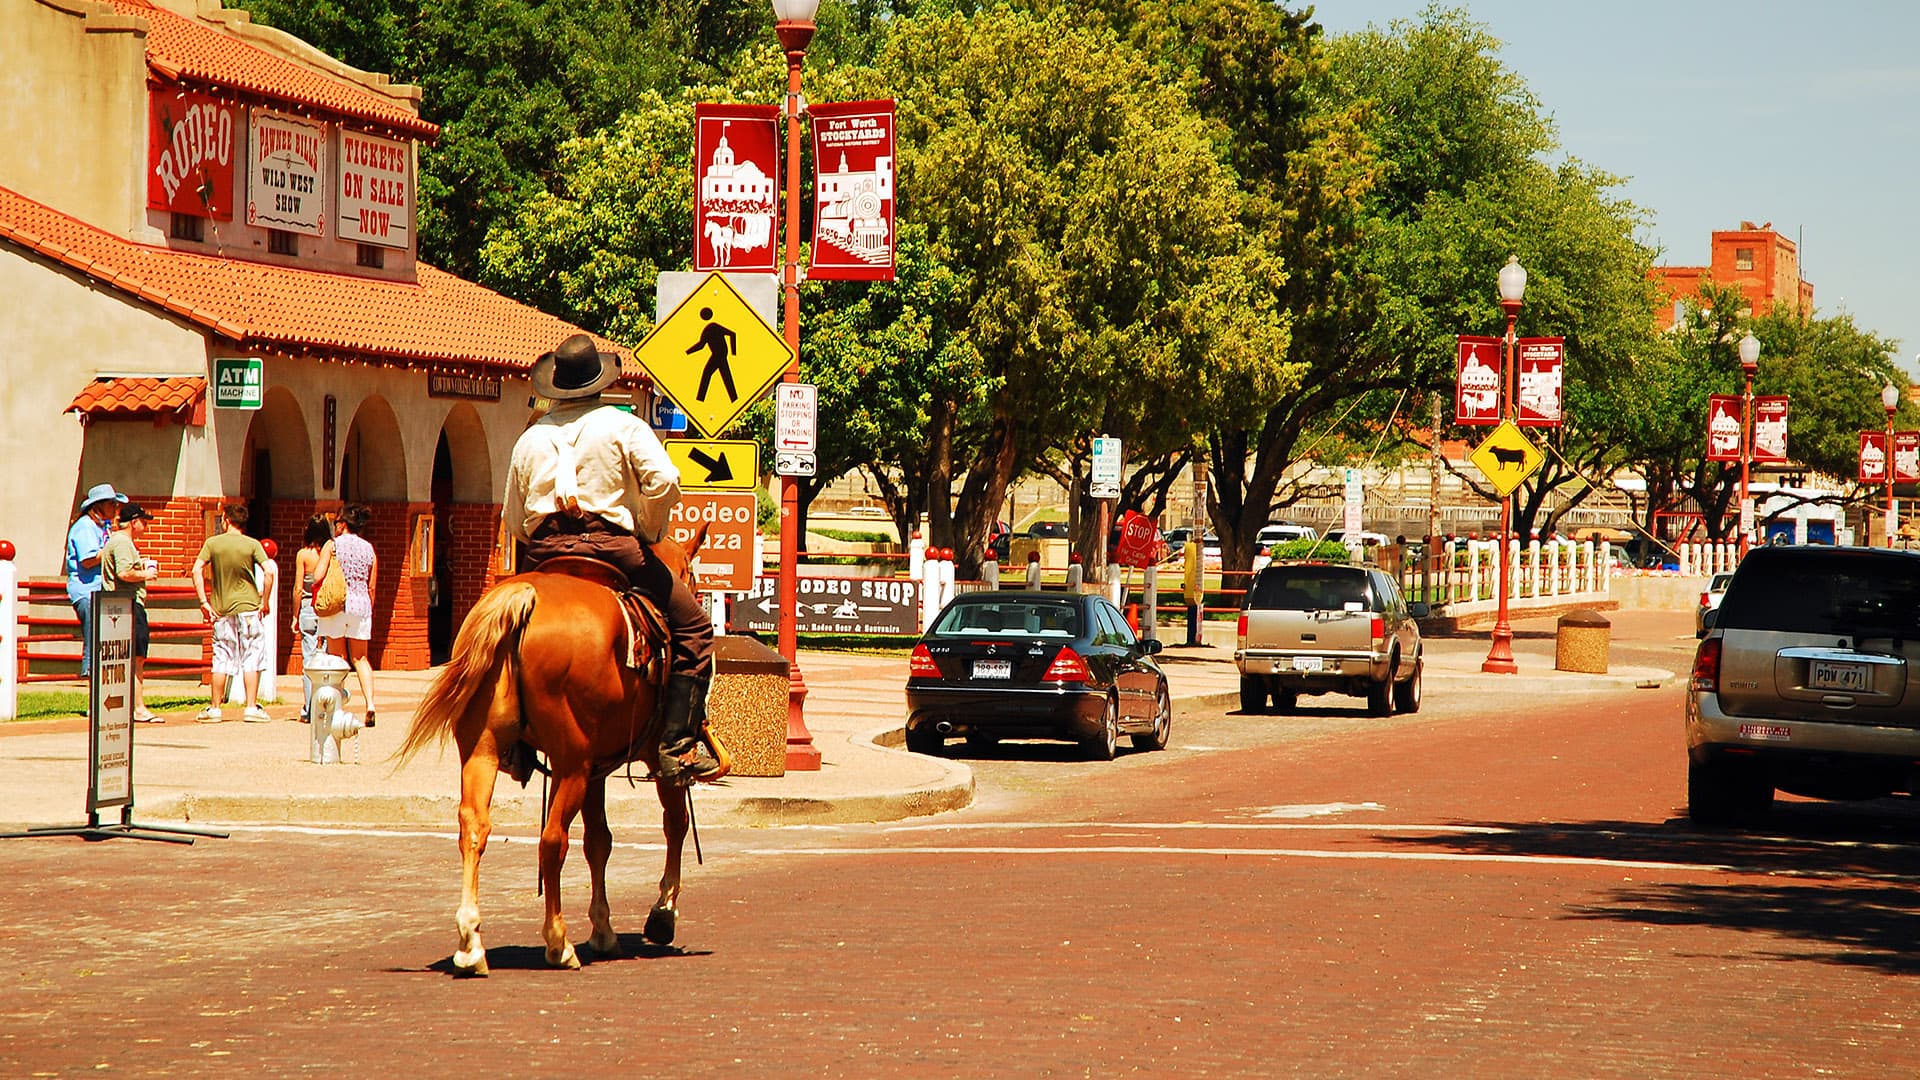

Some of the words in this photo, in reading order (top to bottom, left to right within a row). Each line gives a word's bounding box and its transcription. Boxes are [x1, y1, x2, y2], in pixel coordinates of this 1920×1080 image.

[829, 121, 847, 130] Fort
[851, 118, 877, 128] Worth
[820, 128, 886, 142] STOCKYARDS
[159, 103, 231, 205] RODEO
[259, 126, 291, 163] PAWNEE
[295, 133, 318, 174] BILLS
[345, 137, 404, 174] TICKETS
[262, 168, 286, 188] WILD
[290, 173, 314, 194] WEST
[344, 172, 363, 199] ON
[370, 177, 404, 207] SALE
[275, 194, 301, 214] SHOW
[359, 208, 390, 237] NOW
[220, 368, 259, 384] ATM
[220, 388, 257, 397] MACHINE
[789, 390, 804, 400] NO
[659, 406, 683, 415] Phon
[780, 410, 812, 419] STOPPING
[780, 429, 812, 437] STANDING
[669, 501, 750, 523] Rodeo
[1127, 523, 1151, 539] STOP
[796, 579, 851, 595] ODEO
[861, 580, 915, 607] SHOP
[748, 621, 775, 631] Quality
[811, 623, 833, 632] Rodeo
[835, 623, 852, 632] Gear
[854, 624, 862, 632] &
[864, 624, 900, 633] Souvenirs
[102, 663, 125, 686] DETOUR
